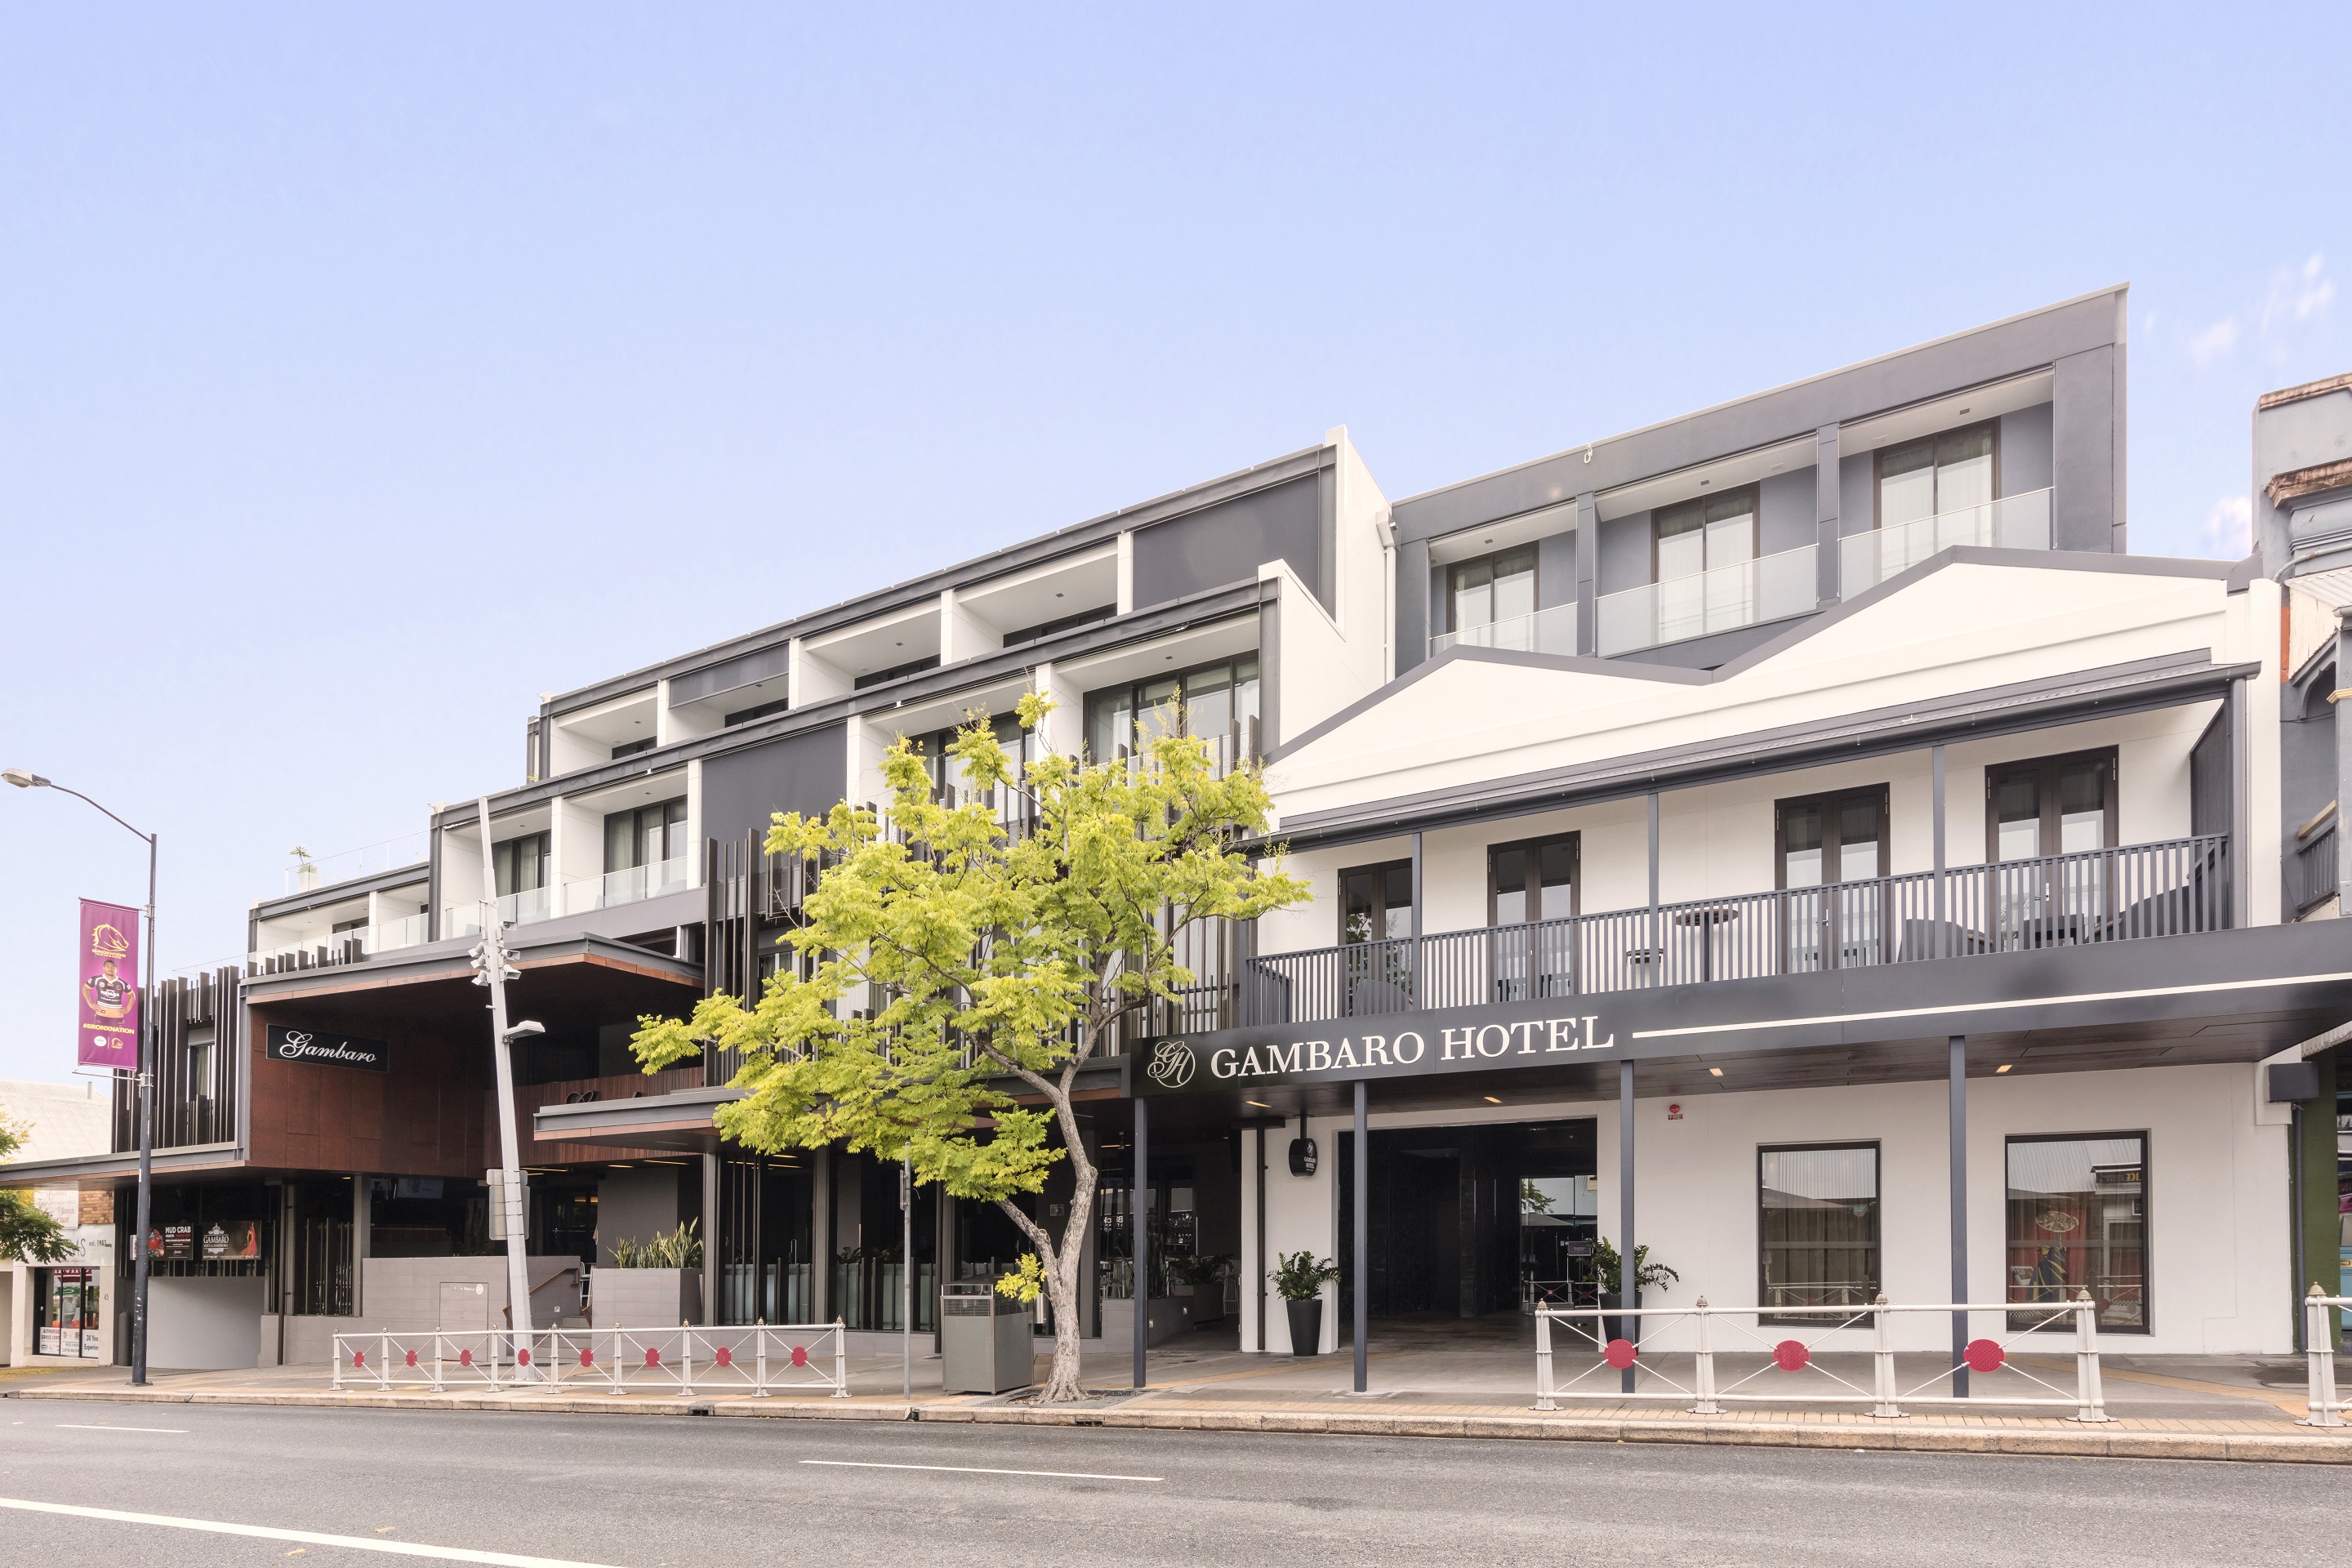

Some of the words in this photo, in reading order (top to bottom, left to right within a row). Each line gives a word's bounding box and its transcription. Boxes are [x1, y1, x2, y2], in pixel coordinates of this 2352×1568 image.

[91, 949, 126, 957] BRONCOS
[83, 1023, 134, 1034] #BRONXNATION
[279, 1031, 376, 1062] Gambaro
[1210, 1031, 1425, 1079] GAMBARO
[1440, 1015, 1614, 1061] HOTEL
[203, 1236, 229, 1244] GAMBARO
